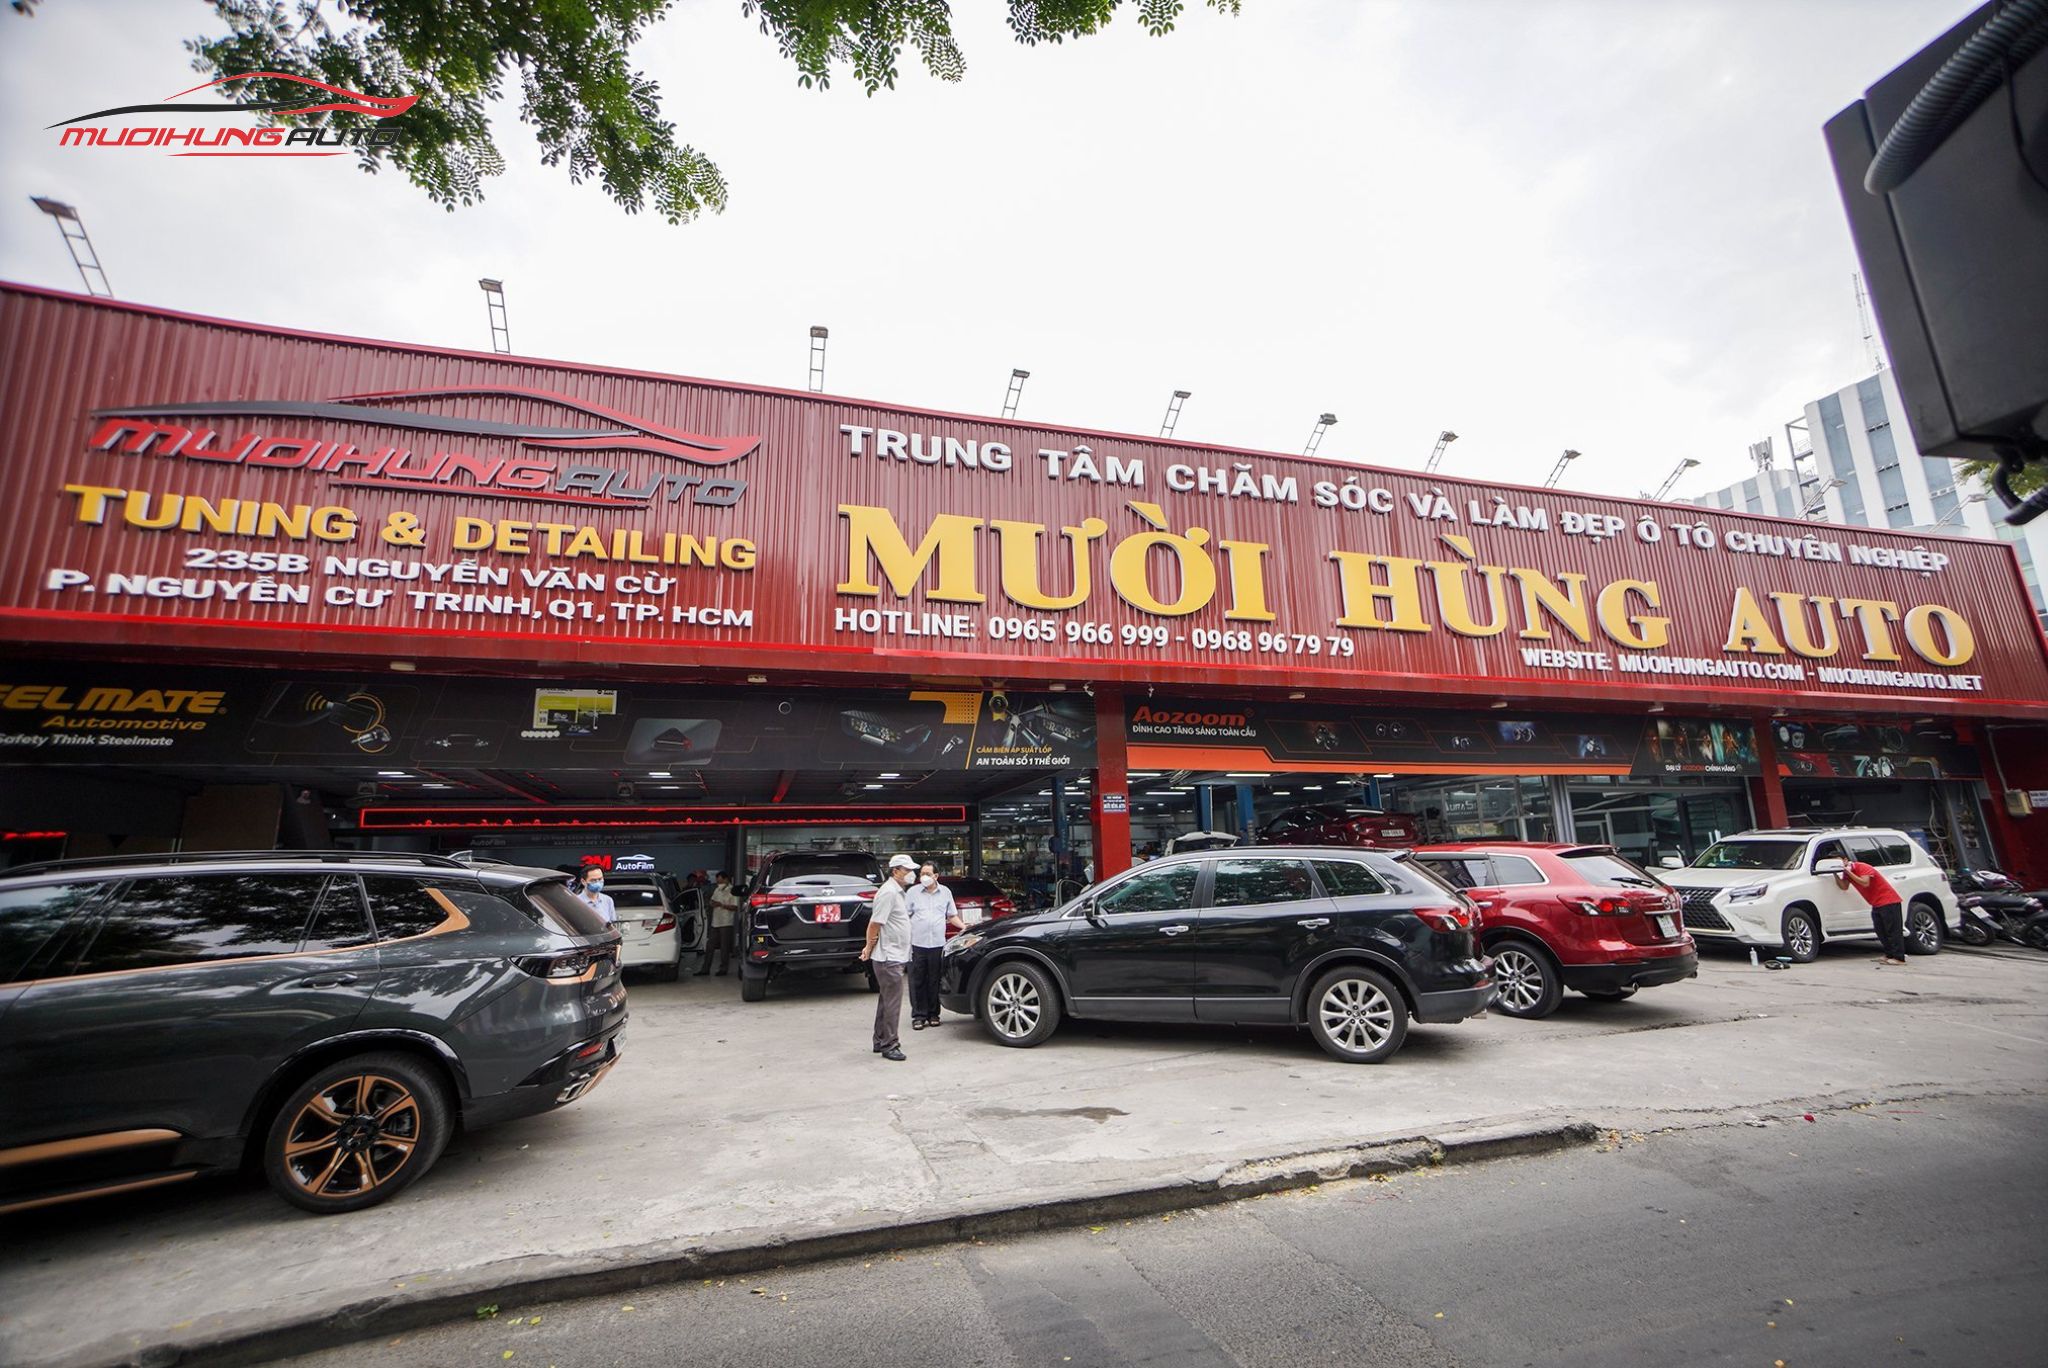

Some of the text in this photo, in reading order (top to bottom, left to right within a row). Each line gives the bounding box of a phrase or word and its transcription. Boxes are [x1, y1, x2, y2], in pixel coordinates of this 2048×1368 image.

[840, 424, 1950, 578] TRUNG TÂM CHĂM SÓC VÀ LÀM ĐẸP Ô TÔ CHUYÊN NGHIỆP
[65, 483, 756, 570] TUNING & DETAILING
[47, 568, 96, 592] P.
[106, 573, 309, 604] NGUYỄN
[185, 548, 677, 596] 235B NGUYỄN VĂN CỪ
[836, 500, 1977, 667] MƯỜI HÙNG AUTO
[834, 607, 976, 638] HOTLINE:
[988, 616, 1058, 642] 0965
[1065, 621, 1114, 645] 966
[1121, 624, 1169, 647] 999
[1191, 628, 1253, 651] 0968
[1520, 648, 1612, 671] WEBSITE:
[1618, 654, 1805, 682] MUOIHUNGAUTO.COM
[1819, 667, 1983, 691] MUOIHUNGAUTO.NET
[0, 684, 226, 714] ELMATE
[1132, 705, 1247, 726] Aozoom
[42, 715, 207, 731] Automotive
[1154, 726, 1172, 734] CAO
[52, 734, 96, 745] Think
[98, 734, 174, 746] Steelmate
[976, 757, 990, 766] AN
[990, 755, 1015, 766] TOÀN
[616, 861, 655, 871] AutoFilm
